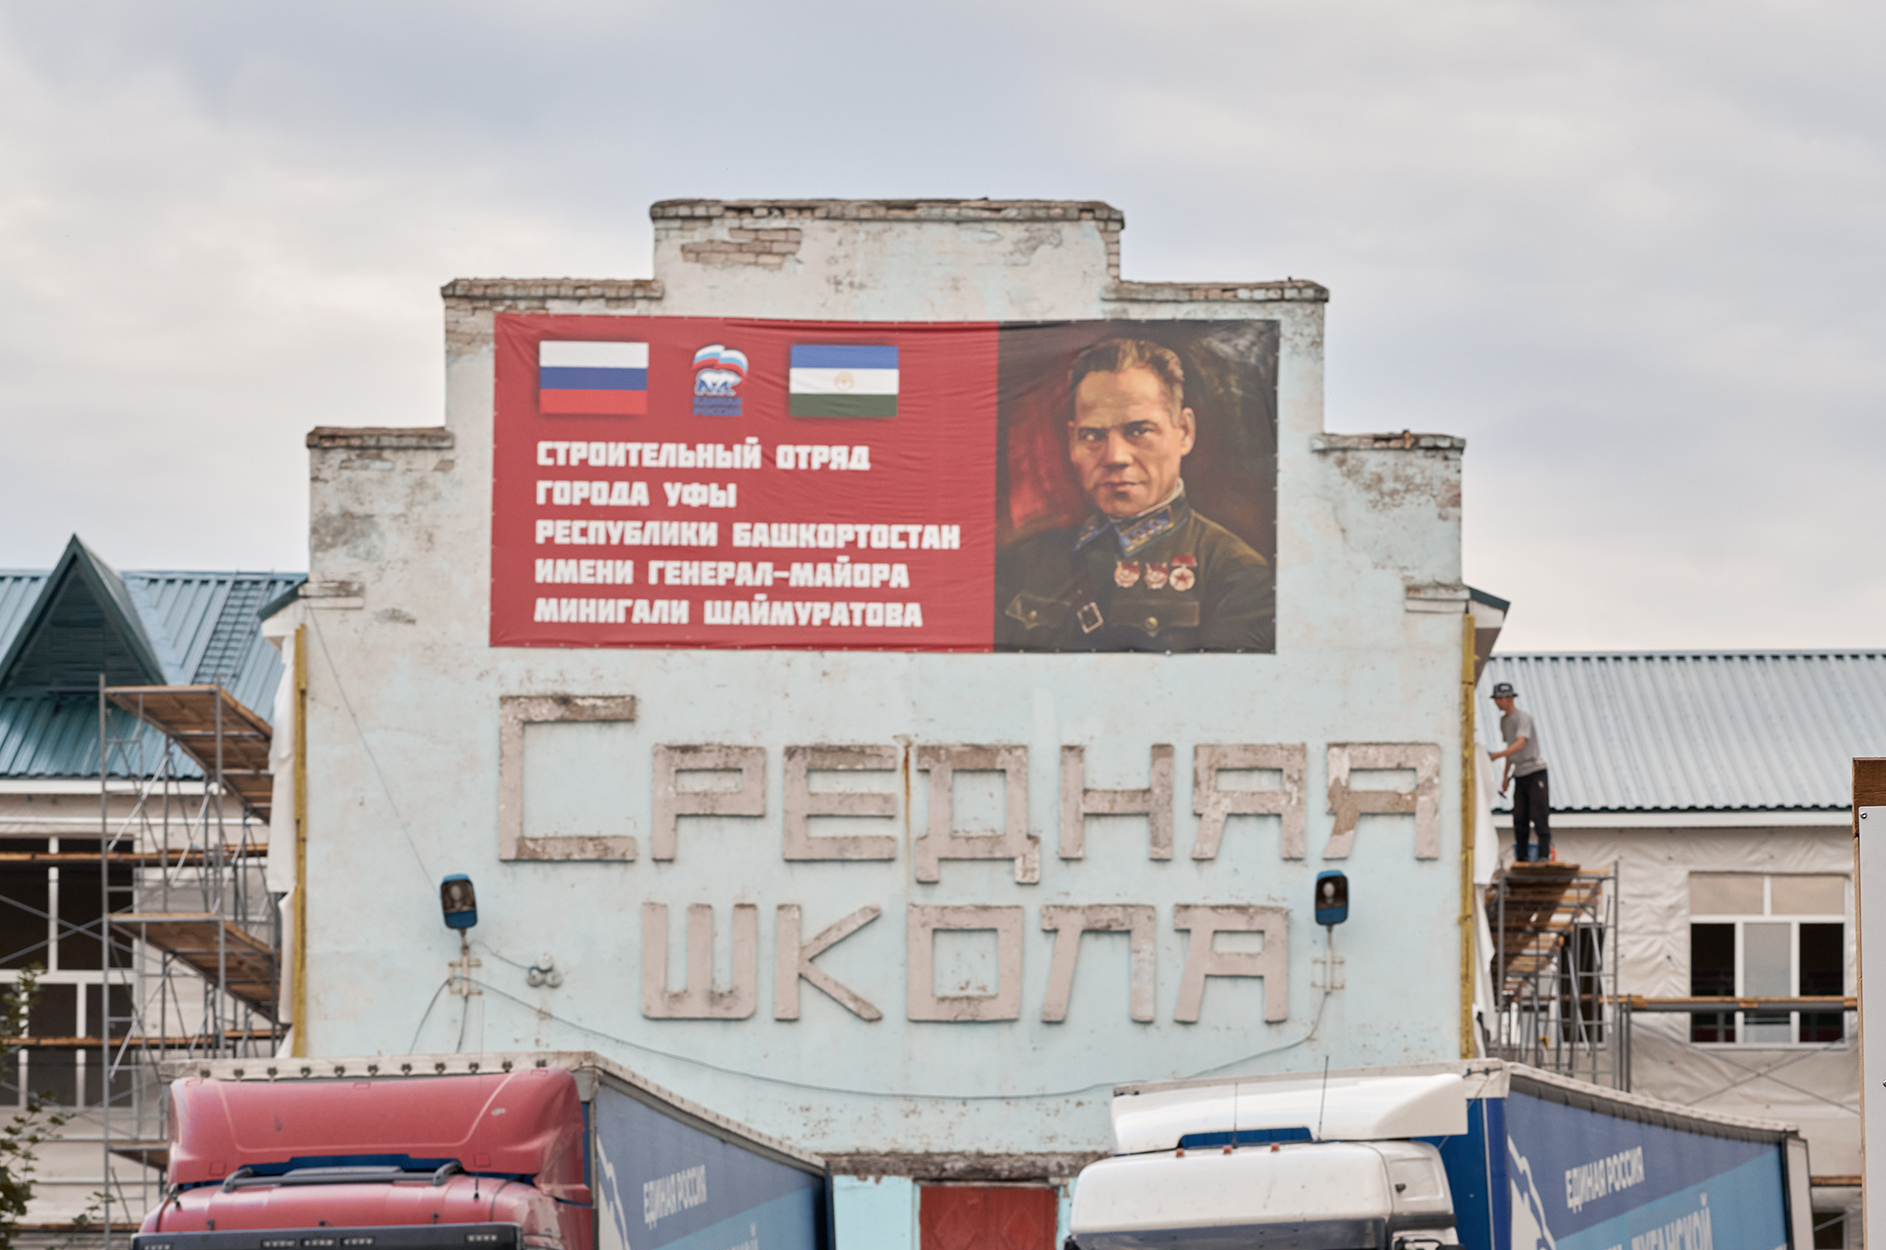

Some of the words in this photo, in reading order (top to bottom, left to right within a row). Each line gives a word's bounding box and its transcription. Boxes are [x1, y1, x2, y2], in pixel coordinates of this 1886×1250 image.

[537, 437, 761, 469] СТРОИТЕЛЬНЫЙ
[776, 445, 871, 471] ОТРЯД
[536, 480, 650, 506] ГОРОДА
[664, 482, 737, 507] УФЫ
[535, 520, 718, 547] РЕСПУБЛИКИ
[732, 522, 961, 550] БАШКОРТОСТАН
[535, 559, 634, 584] ИМЕНИ
[648, 555, 910, 588] ГЕНЕРАЛ-МАЙОРА
[534, 598, 689, 625] МИНИГАЛИ
[703, 593, 923, 627] ШАЙМУРАТОВА
[642, 902, 1289, 1023] ШКОЛА
[1565, 1159, 1607, 1214] ЕДИНАЯ
[1606, 1146, 1645, 1194] РОССИЯ
